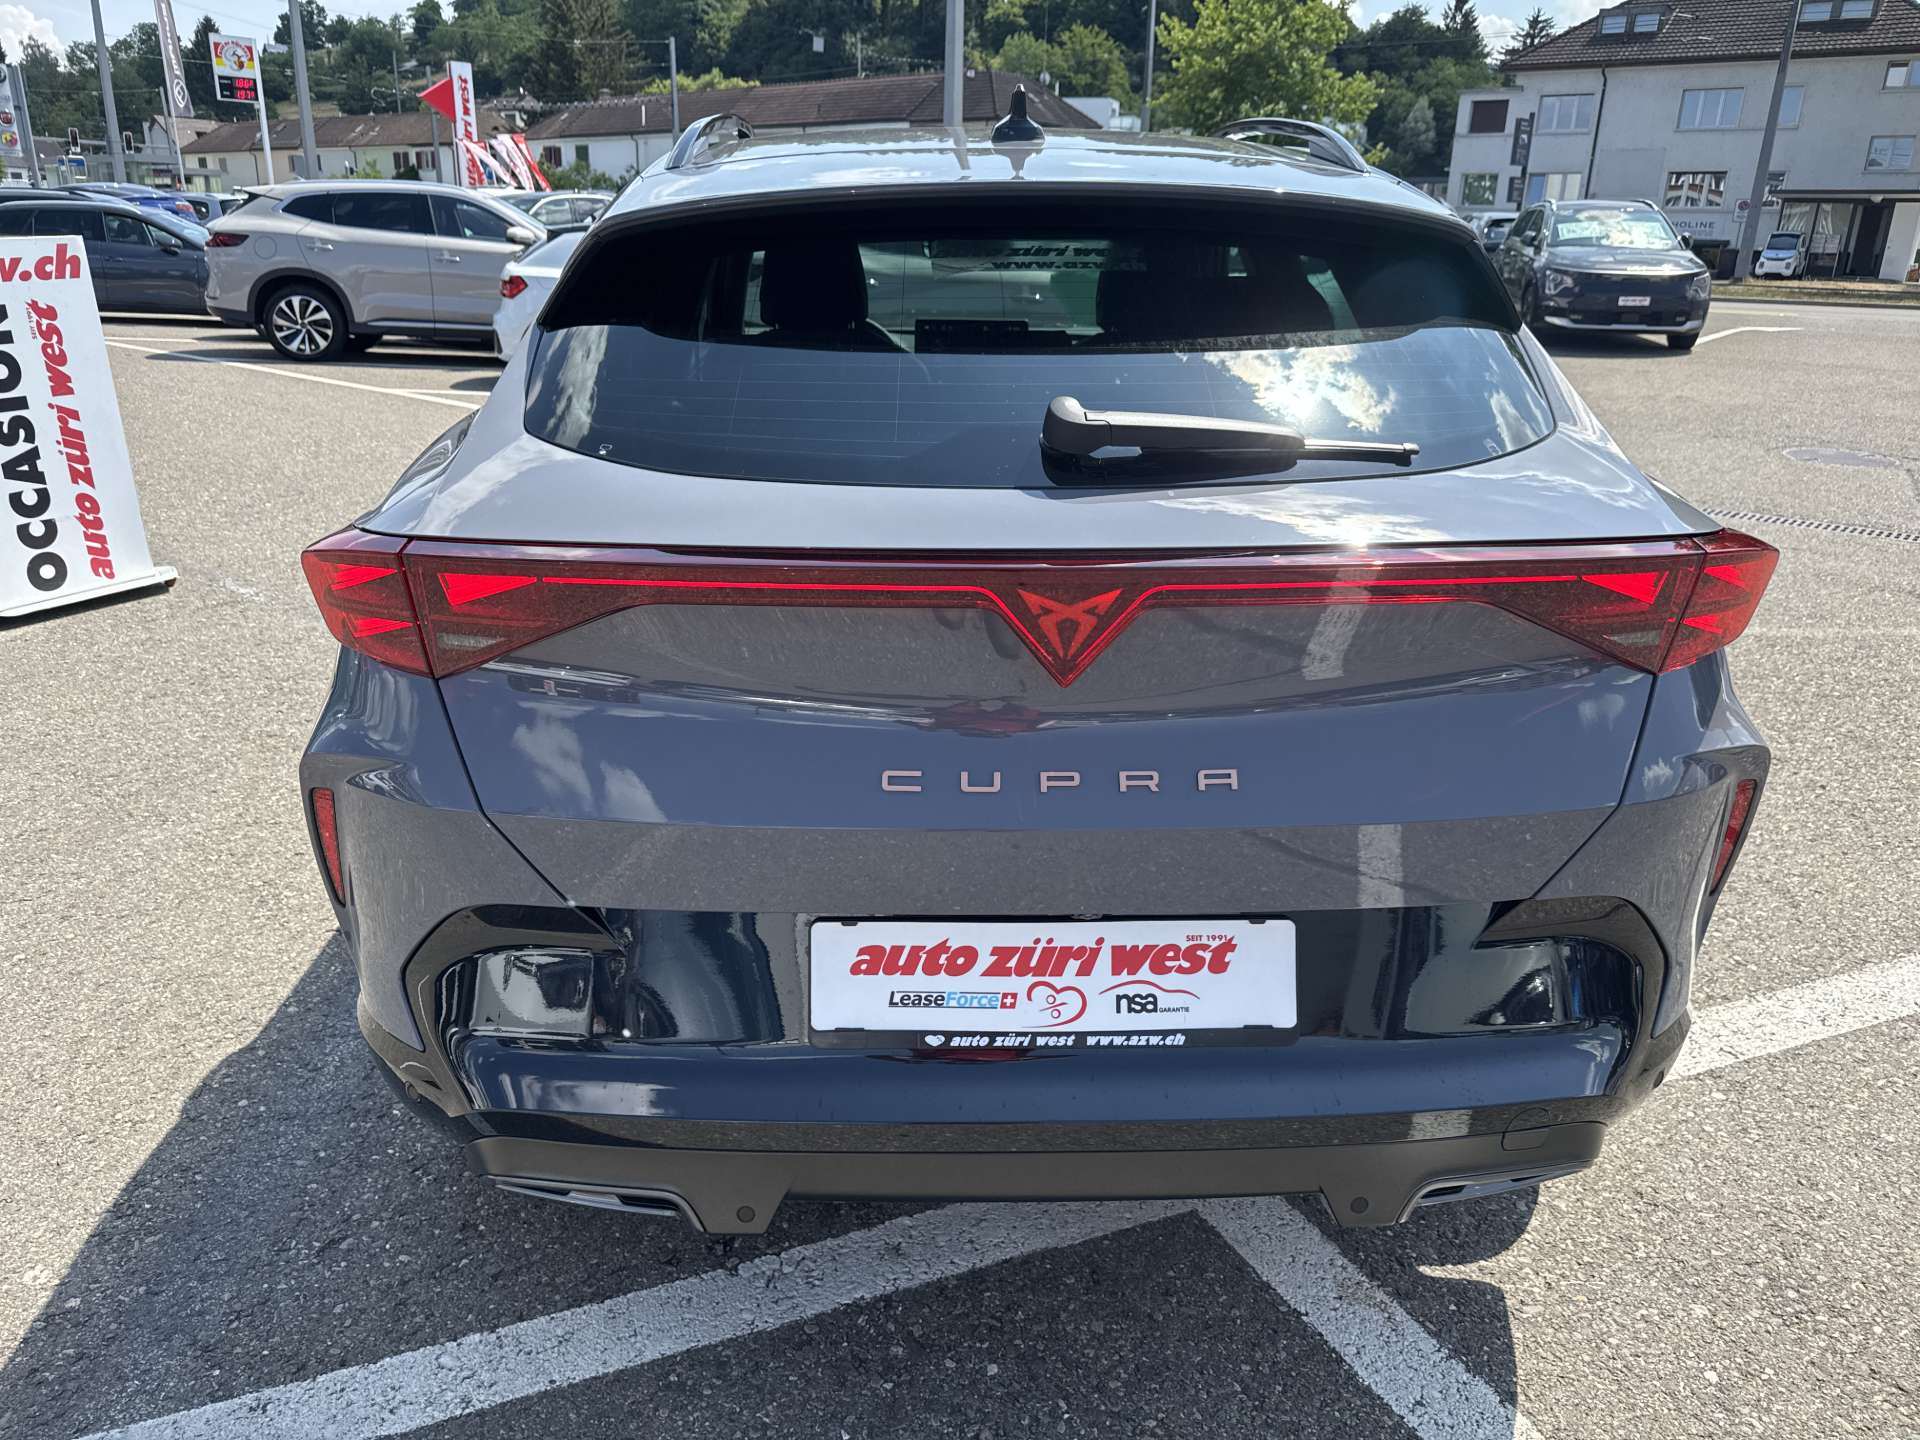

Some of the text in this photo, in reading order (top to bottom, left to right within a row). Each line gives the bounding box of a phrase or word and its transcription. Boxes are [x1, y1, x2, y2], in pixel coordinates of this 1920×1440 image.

[25, 298, 116, 580] auto züri west
[881, 769, 1240, 793] CUPRA
[849, 936, 1238, 977] auto züri west
[889, 990, 999, 1007] LeaseForce
[1115, 993, 1159, 1014] nsa
[950, 1033, 1186, 1047] auto züri west www.azw.ch
